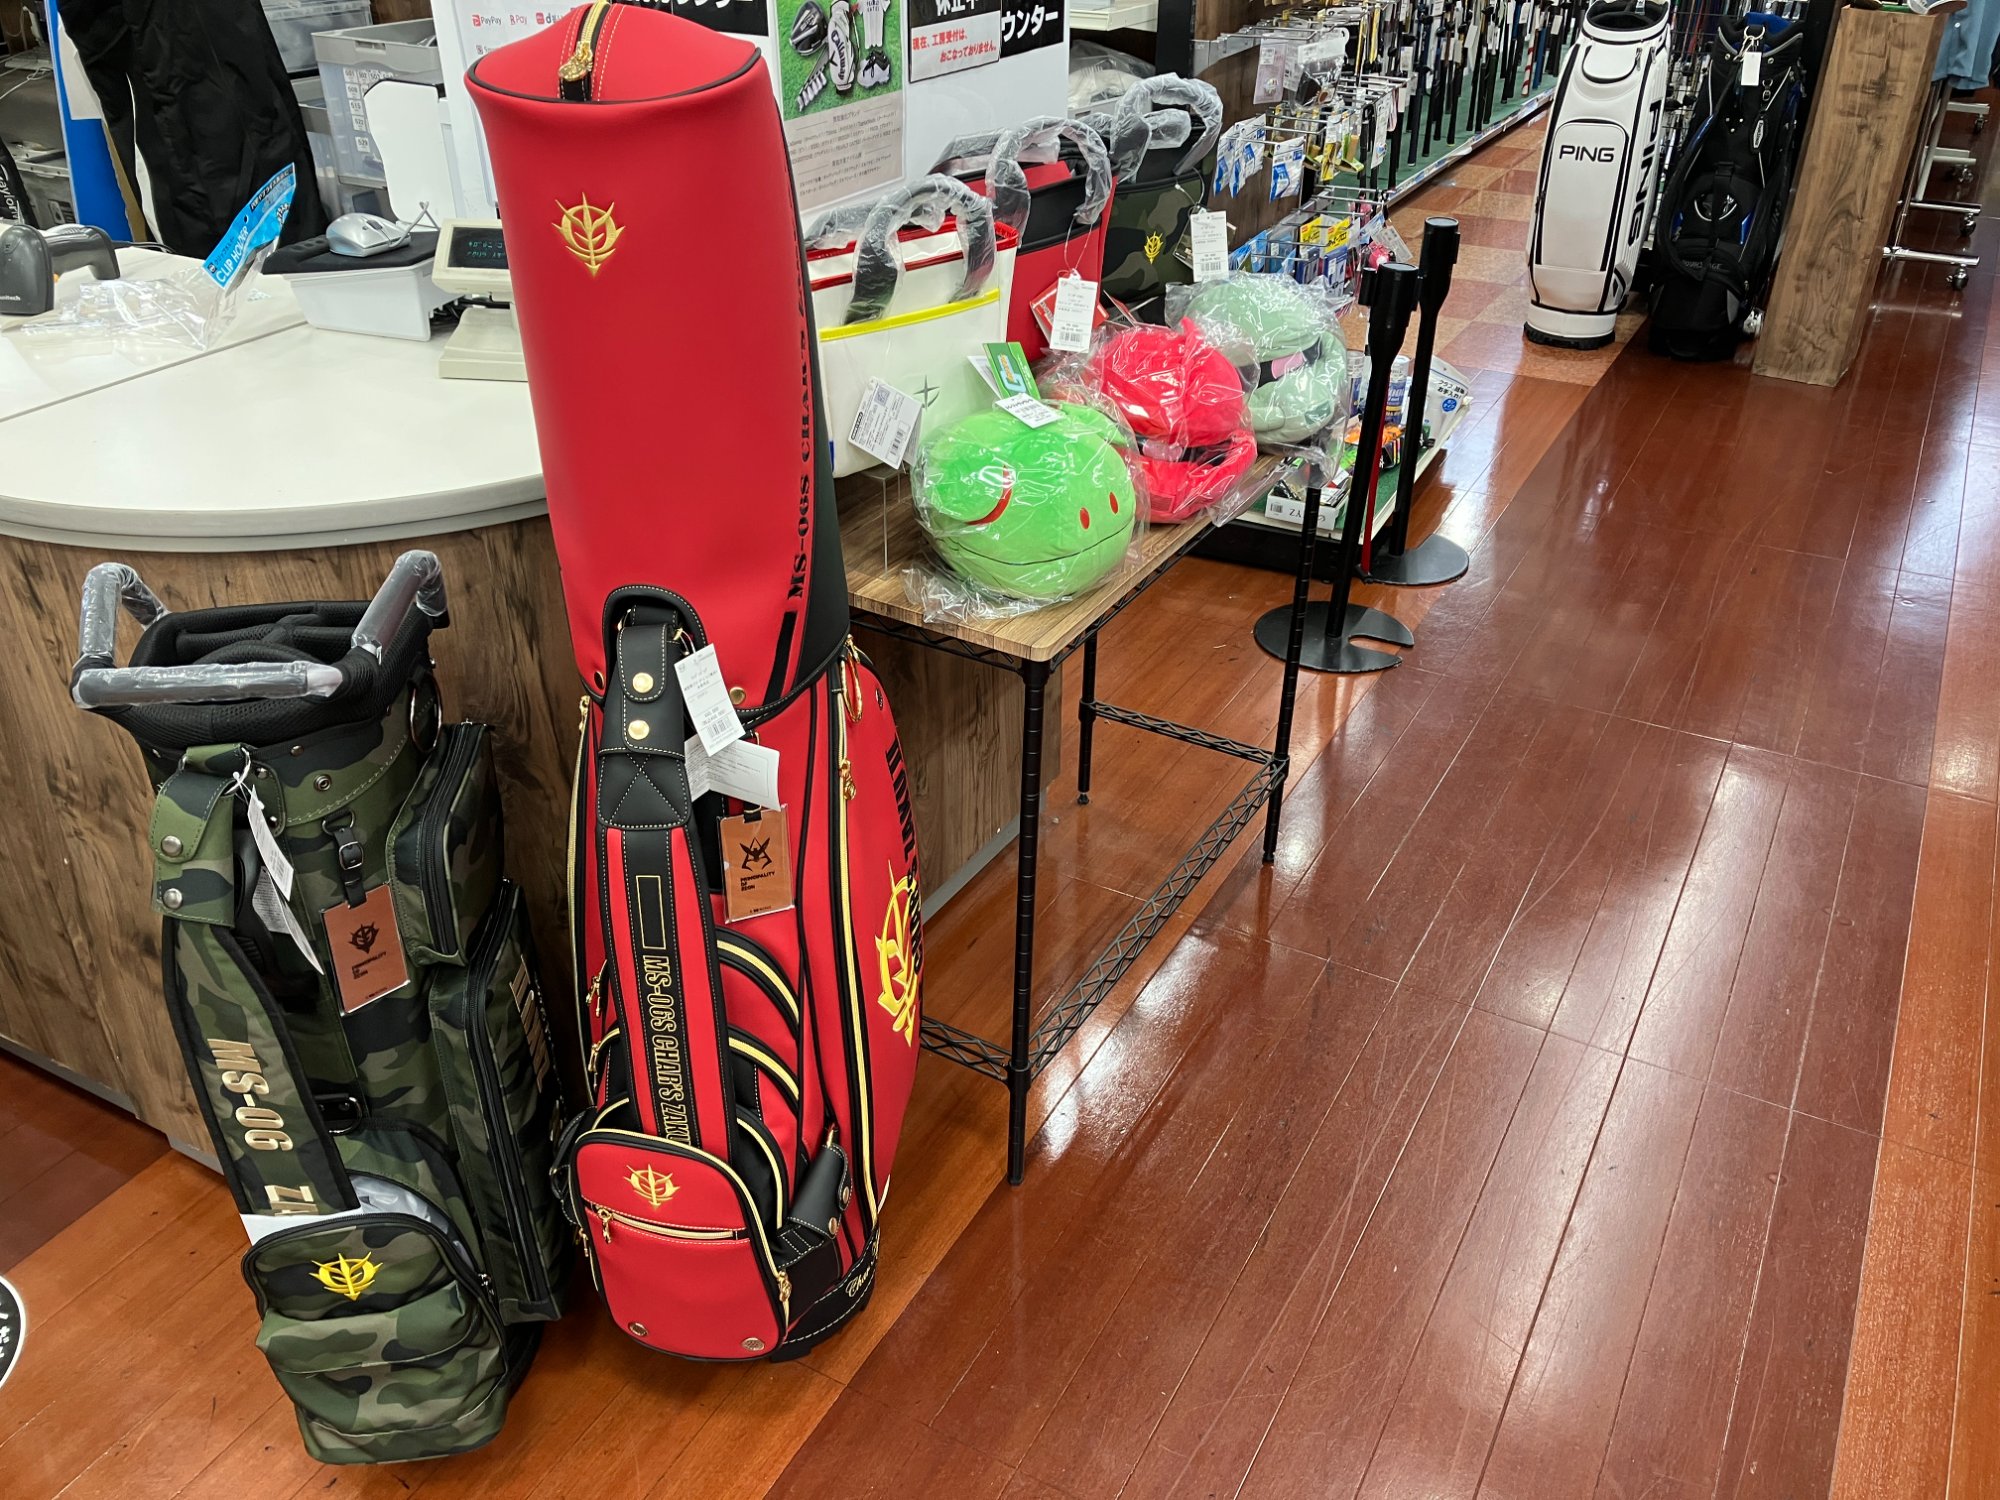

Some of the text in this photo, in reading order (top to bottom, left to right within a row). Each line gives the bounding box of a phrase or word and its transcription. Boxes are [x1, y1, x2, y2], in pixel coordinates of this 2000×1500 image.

[940, 39, 997, 64] おこなっておりません。
[1559, 144, 1615, 163] PING
[1627, 98, 1662, 248] PING
[215, 225, 250, 284] CLIP HOLDER
[787, 475, 810, 600] MS-06S
[643, 955, 677, 1032] MS-06S
[207, 1038, 294, 1152] MS-06
[652, 1035, 685, 1101] CHAR'S
